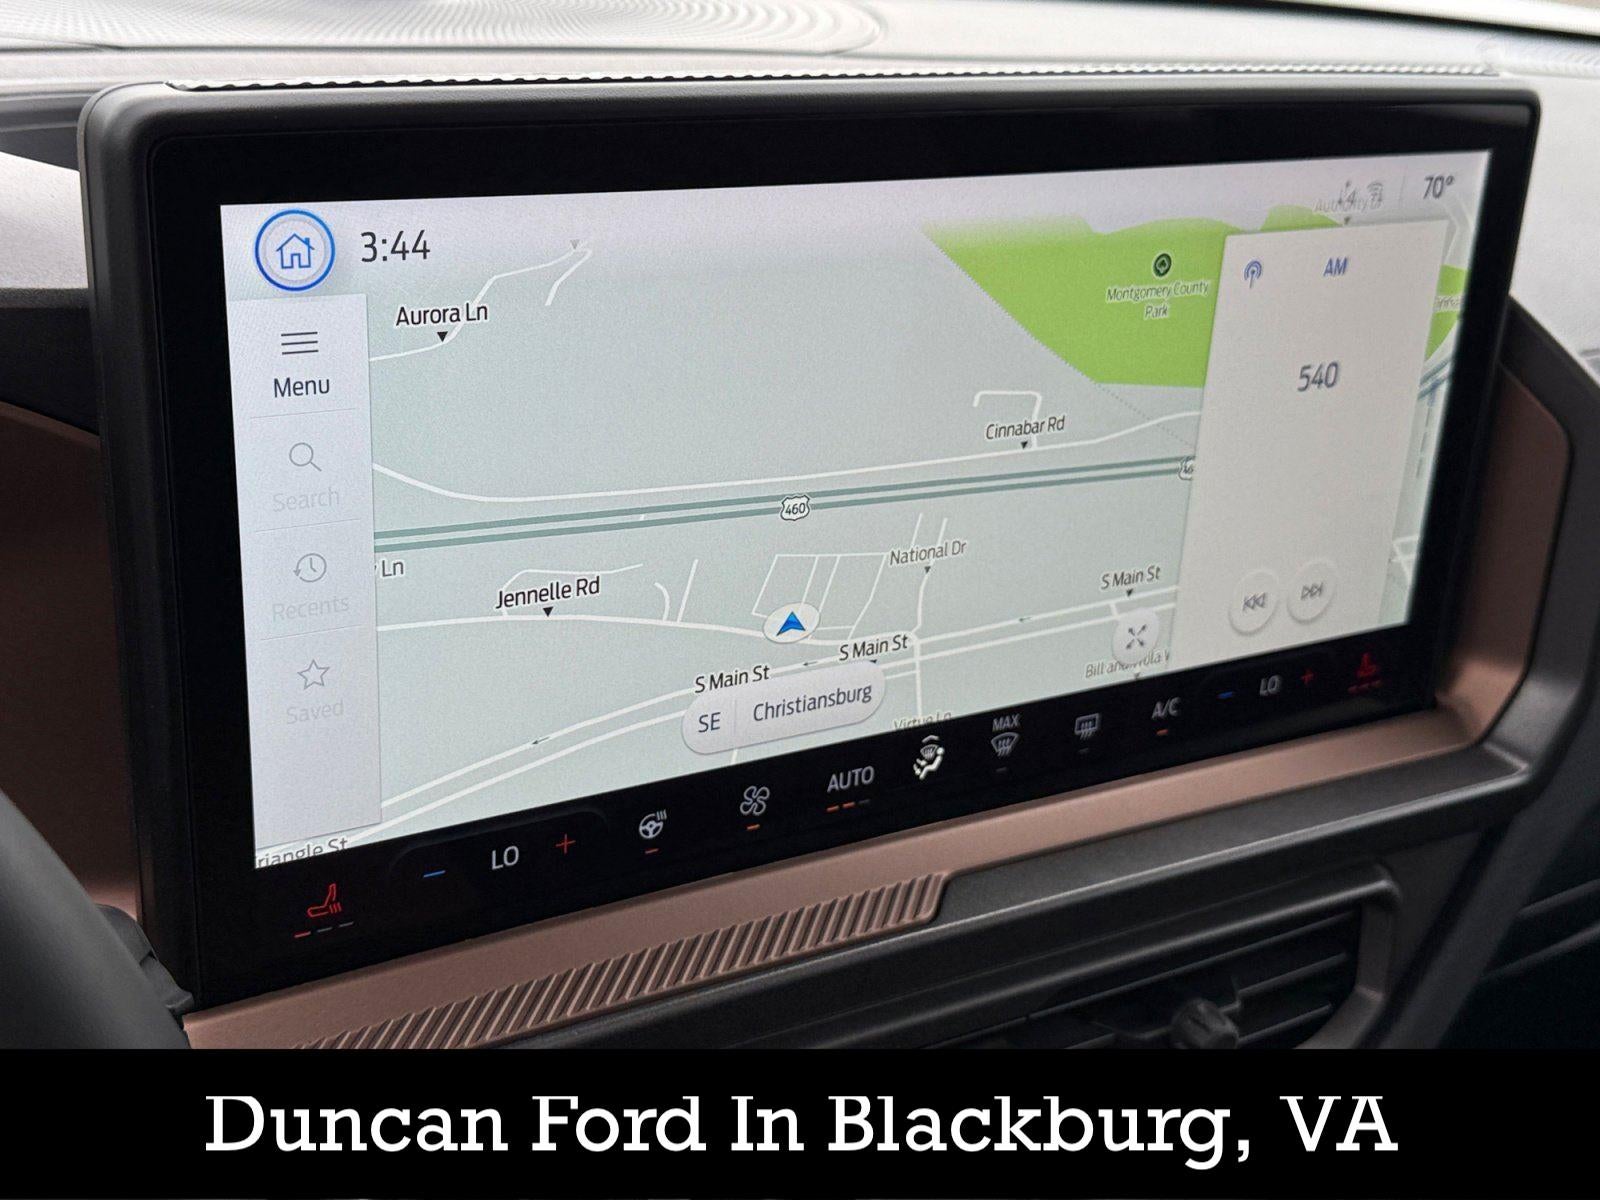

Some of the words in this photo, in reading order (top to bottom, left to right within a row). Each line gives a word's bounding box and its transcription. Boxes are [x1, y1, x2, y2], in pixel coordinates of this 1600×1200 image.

[361, 229, 431, 263] 3:44
[1323, 257, 1349, 276] AM
[1106, 285, 1172, 305] Montgomery
[1173, 281, 1208, 298] County
[395, 307, 461, 327] Aurora
[465, 303, 489, 322] Ln
[1145, 303, 1168, 319] Park
[273, 376, 331, 399] Menu
[1297, 361, 1339, 392] 540
[986, 420, 1045, 440] Cinnabar
[1047, 415, 1066, 432] Rd
[272, 485, 340, 512] Search
[784, 501, 807, 516] 460
[889, 544, 947, 566] National
[951, 540, 968, 556] Dr
[382, 559, 404, 577] Ln
[1101, 575, 1110, 589] S
[1112, 570, 1144, 587] Main
[1146, 565, 1161, 581] St
[495, 582, 572, 609] Jennelle
[576, 576, 601, 596] Rd
[272, 595, 350, 622] Recents
[839, 644, 849, 661] S
[852, 639, 889, 658] Main
[890, 634, 908, 651] St
[695, 677, 705, 693] S
[708, 669, 749, 690] Main
[751, 664, 769, 682] St
[1085, 662, 1104, 679] Bill
[1260, 676, 1281, 696] LO
[286, 701, 345, 725] Saved
[753, 686, 872, 721] Christiansburg
[1153, 699, 1179, 718] A/C
[698, 713, 721, 733] SE
[992, 716, 1020, 731] MAX
[827, 766, 875, 792] AUTO
[256, 844, 323, 867] riangle
[328, 838, 348, 850] St
[491, 846, 519, 870] LO
